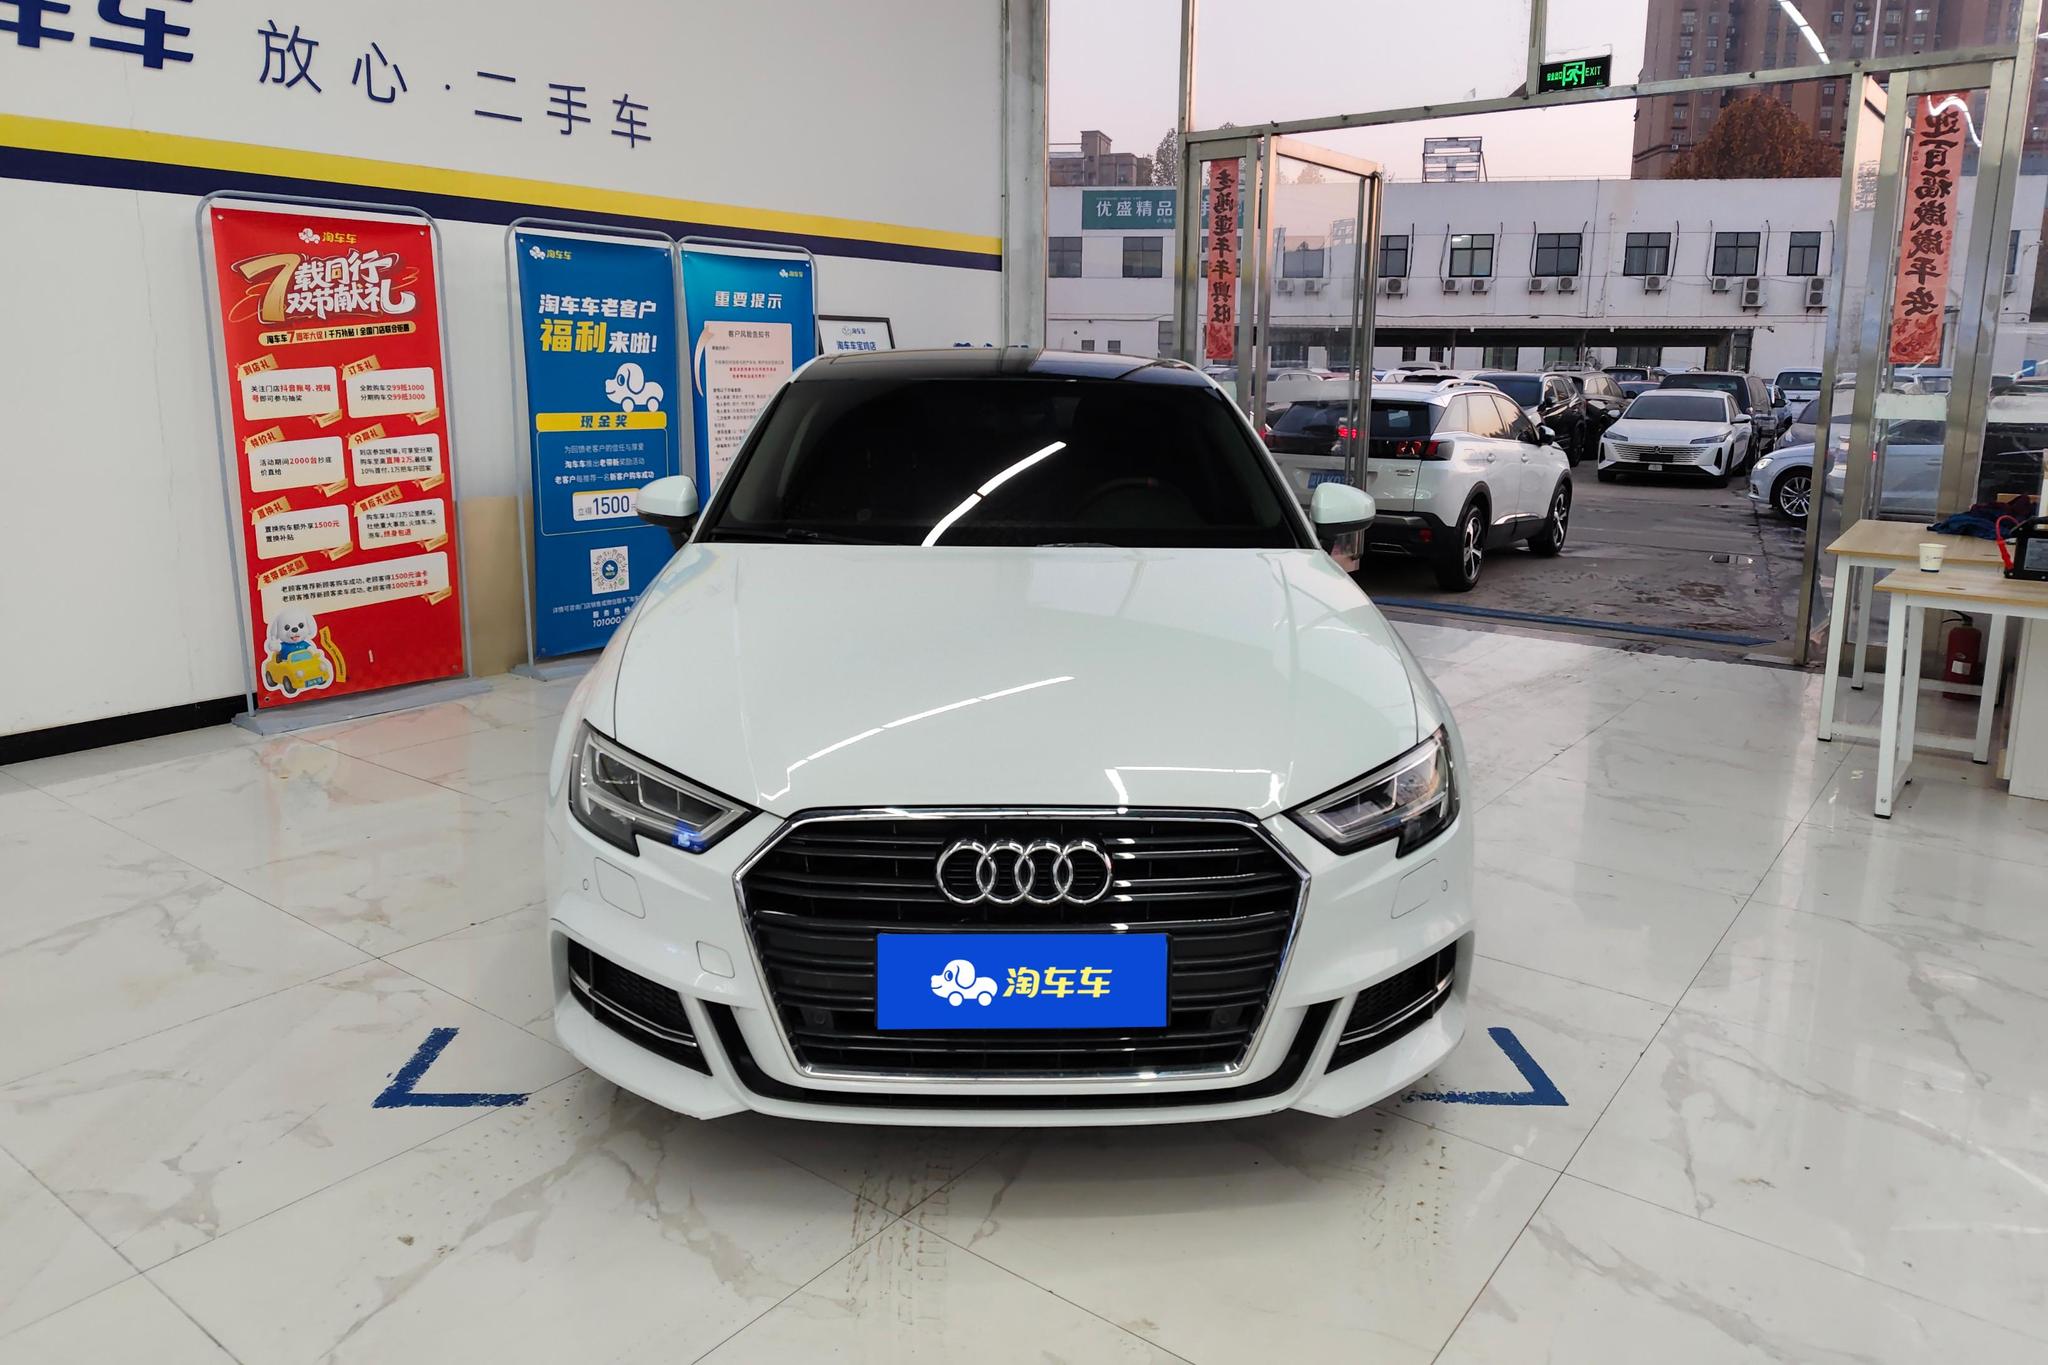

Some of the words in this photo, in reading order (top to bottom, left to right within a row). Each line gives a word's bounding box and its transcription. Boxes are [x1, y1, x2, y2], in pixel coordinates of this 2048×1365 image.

[1585, 65, 1601, 77] EXIT
[322, 231, 357, 244] 淘车车
[546, 249, 572, 260] 淘车车
[286, 279, 416, 320] 双节献礼
[539, 294, 657, 319] 淘车车老客户
[715, 291, 783, 309] 重要提示
[243, 359, 271, 376] 到店礼
[348, 360, 373, 376] 订车礼
[581, 415, 628, 428] 现金奖
[250, 431, 276, 448] 特价礼
